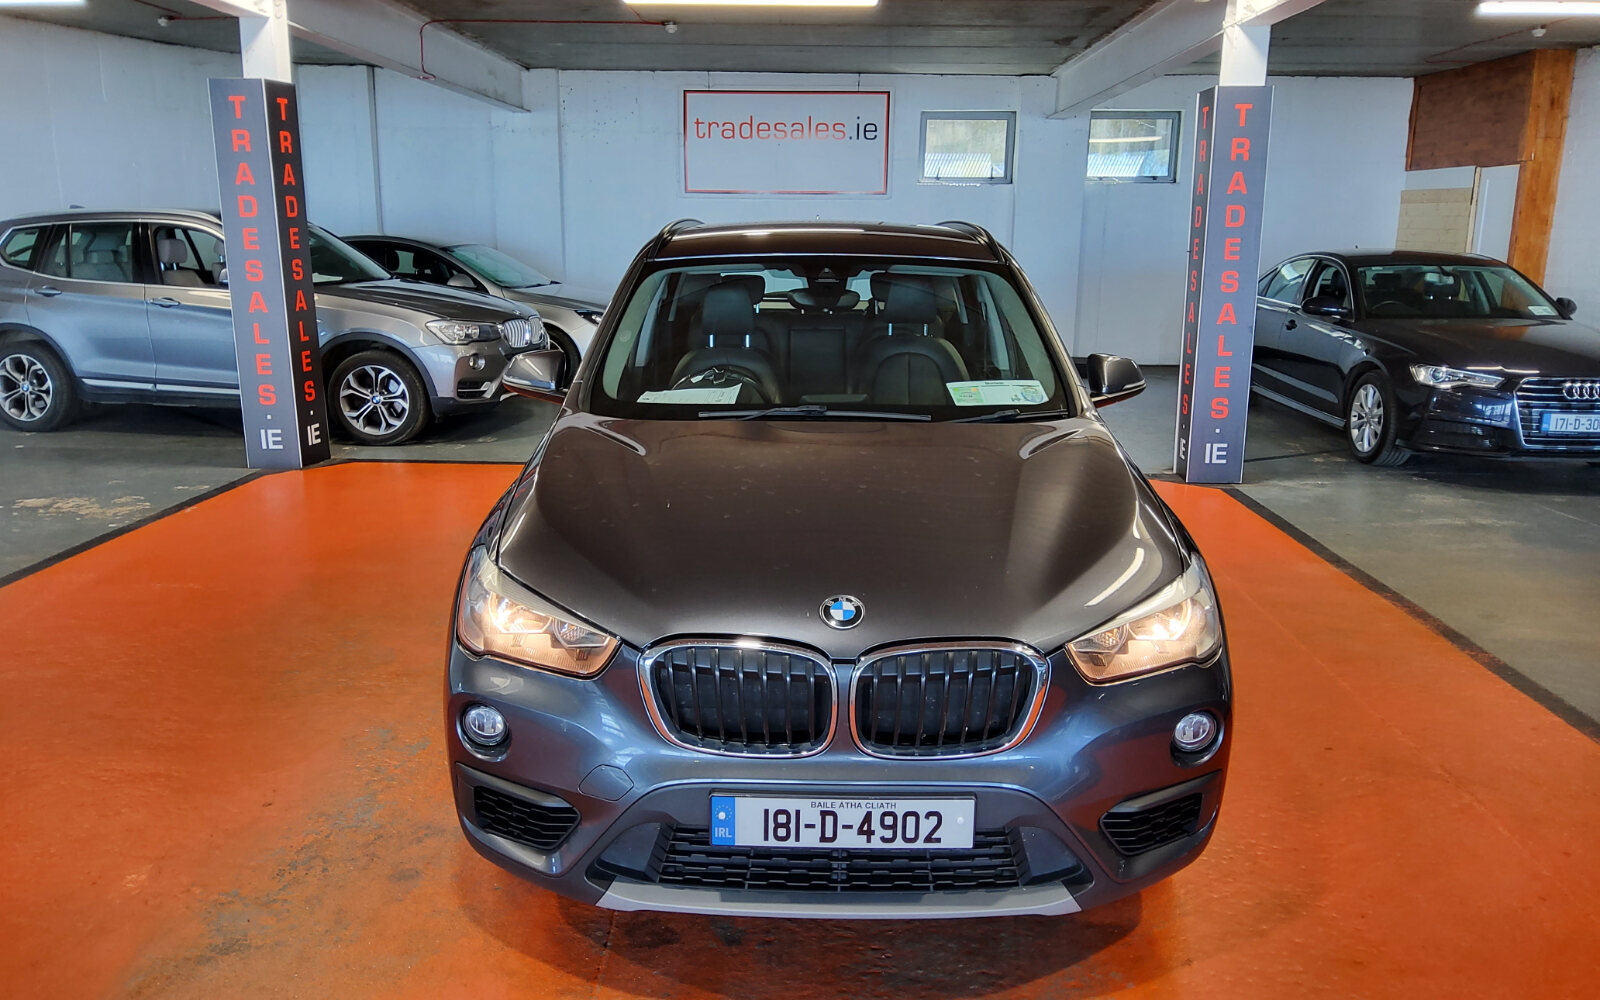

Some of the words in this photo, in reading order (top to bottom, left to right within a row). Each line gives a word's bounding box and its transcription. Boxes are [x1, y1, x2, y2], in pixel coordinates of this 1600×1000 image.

[693, 115, 878, 141] tradesales.ie
[1555, 417, 1600, 430] 171-D-30
[810, 801, 836, 809] BAILE
[714, 827, 733, 838] IRL
[763, 808, 943, 844] 181-D-4902
